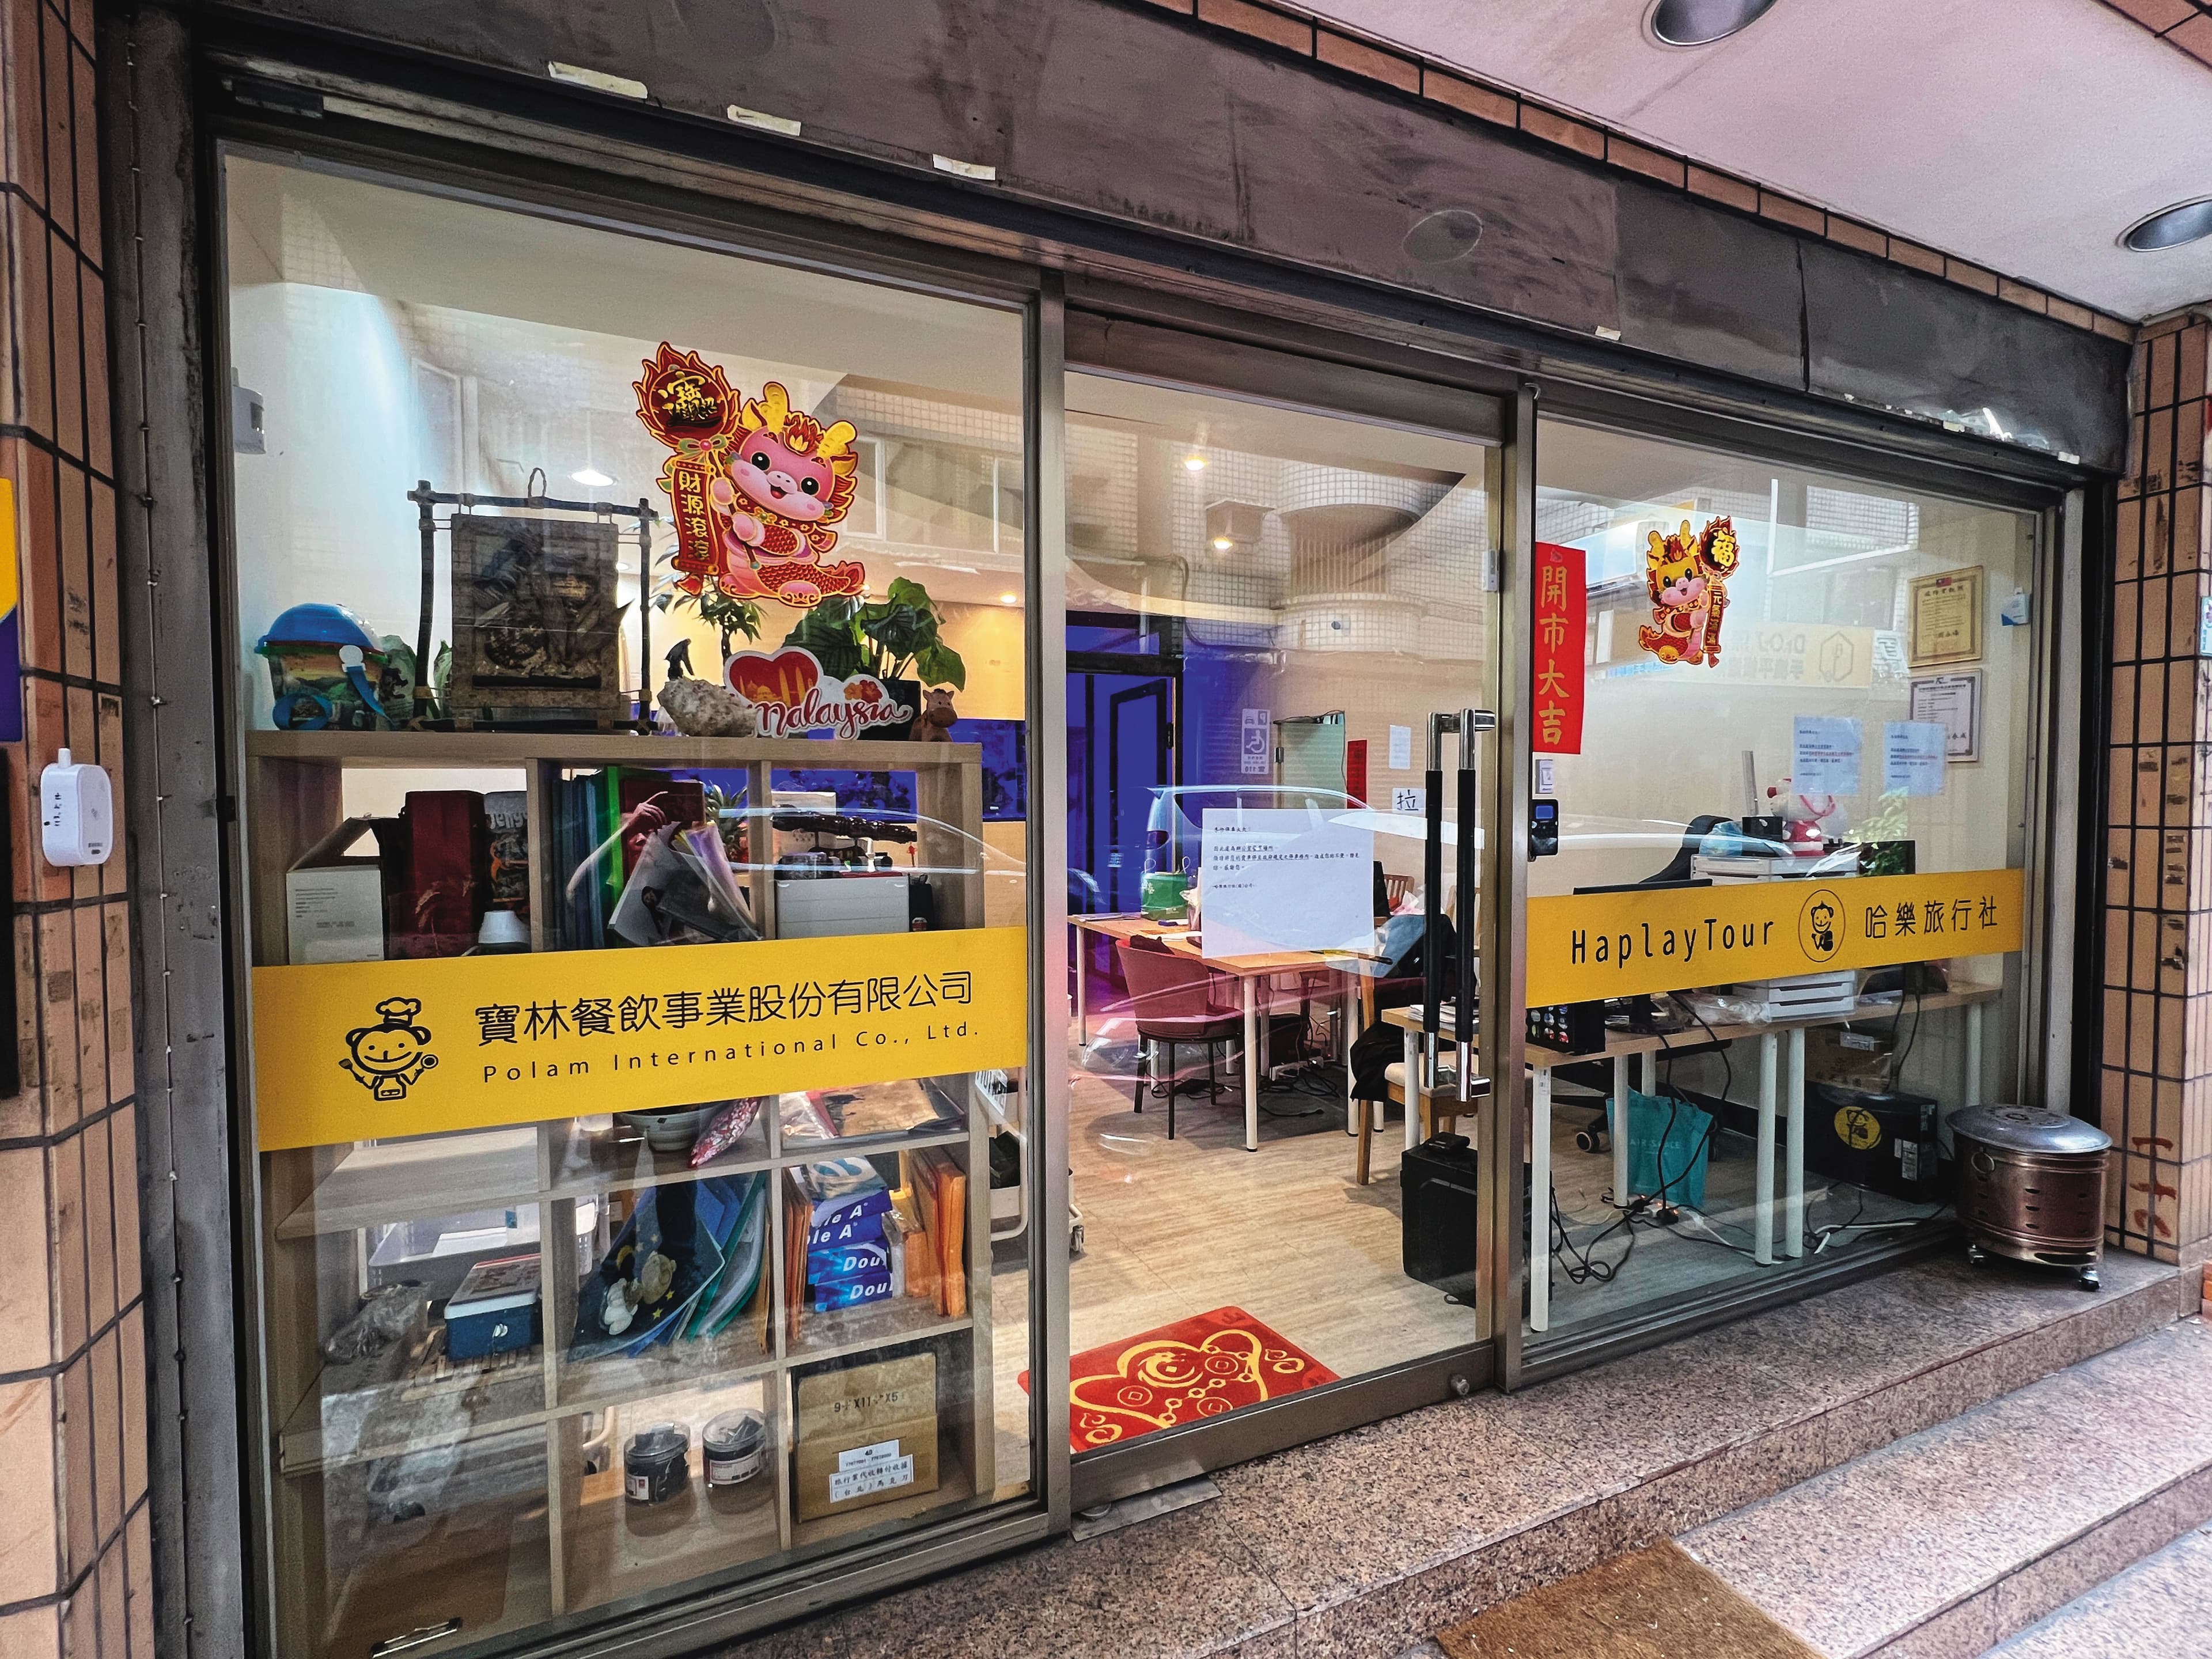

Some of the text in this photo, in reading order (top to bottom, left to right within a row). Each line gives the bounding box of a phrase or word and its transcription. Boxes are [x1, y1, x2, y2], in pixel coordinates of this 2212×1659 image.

[678, 471, 709, 560] 財源滾滾
[1539, 565, 1570, 745] 開市大吉
[1396, 789, 1419, 810] 拉
[1865, 896, 1998, 940] 哈樂旅行社
[1571, 918, 1774, 969] HaplayTour
[475, 970, 972, 1047] 寶林餐飲事業股份有限公司
[484, 1021, 979, 1083] Polam International Co., Ltd.
[839, 1224, 852, 1239] A
[850, 1205, 863, 1219] A
[843, 1256, 882, 1272] Dou
[850, 1282, 893, 1300] Dou
